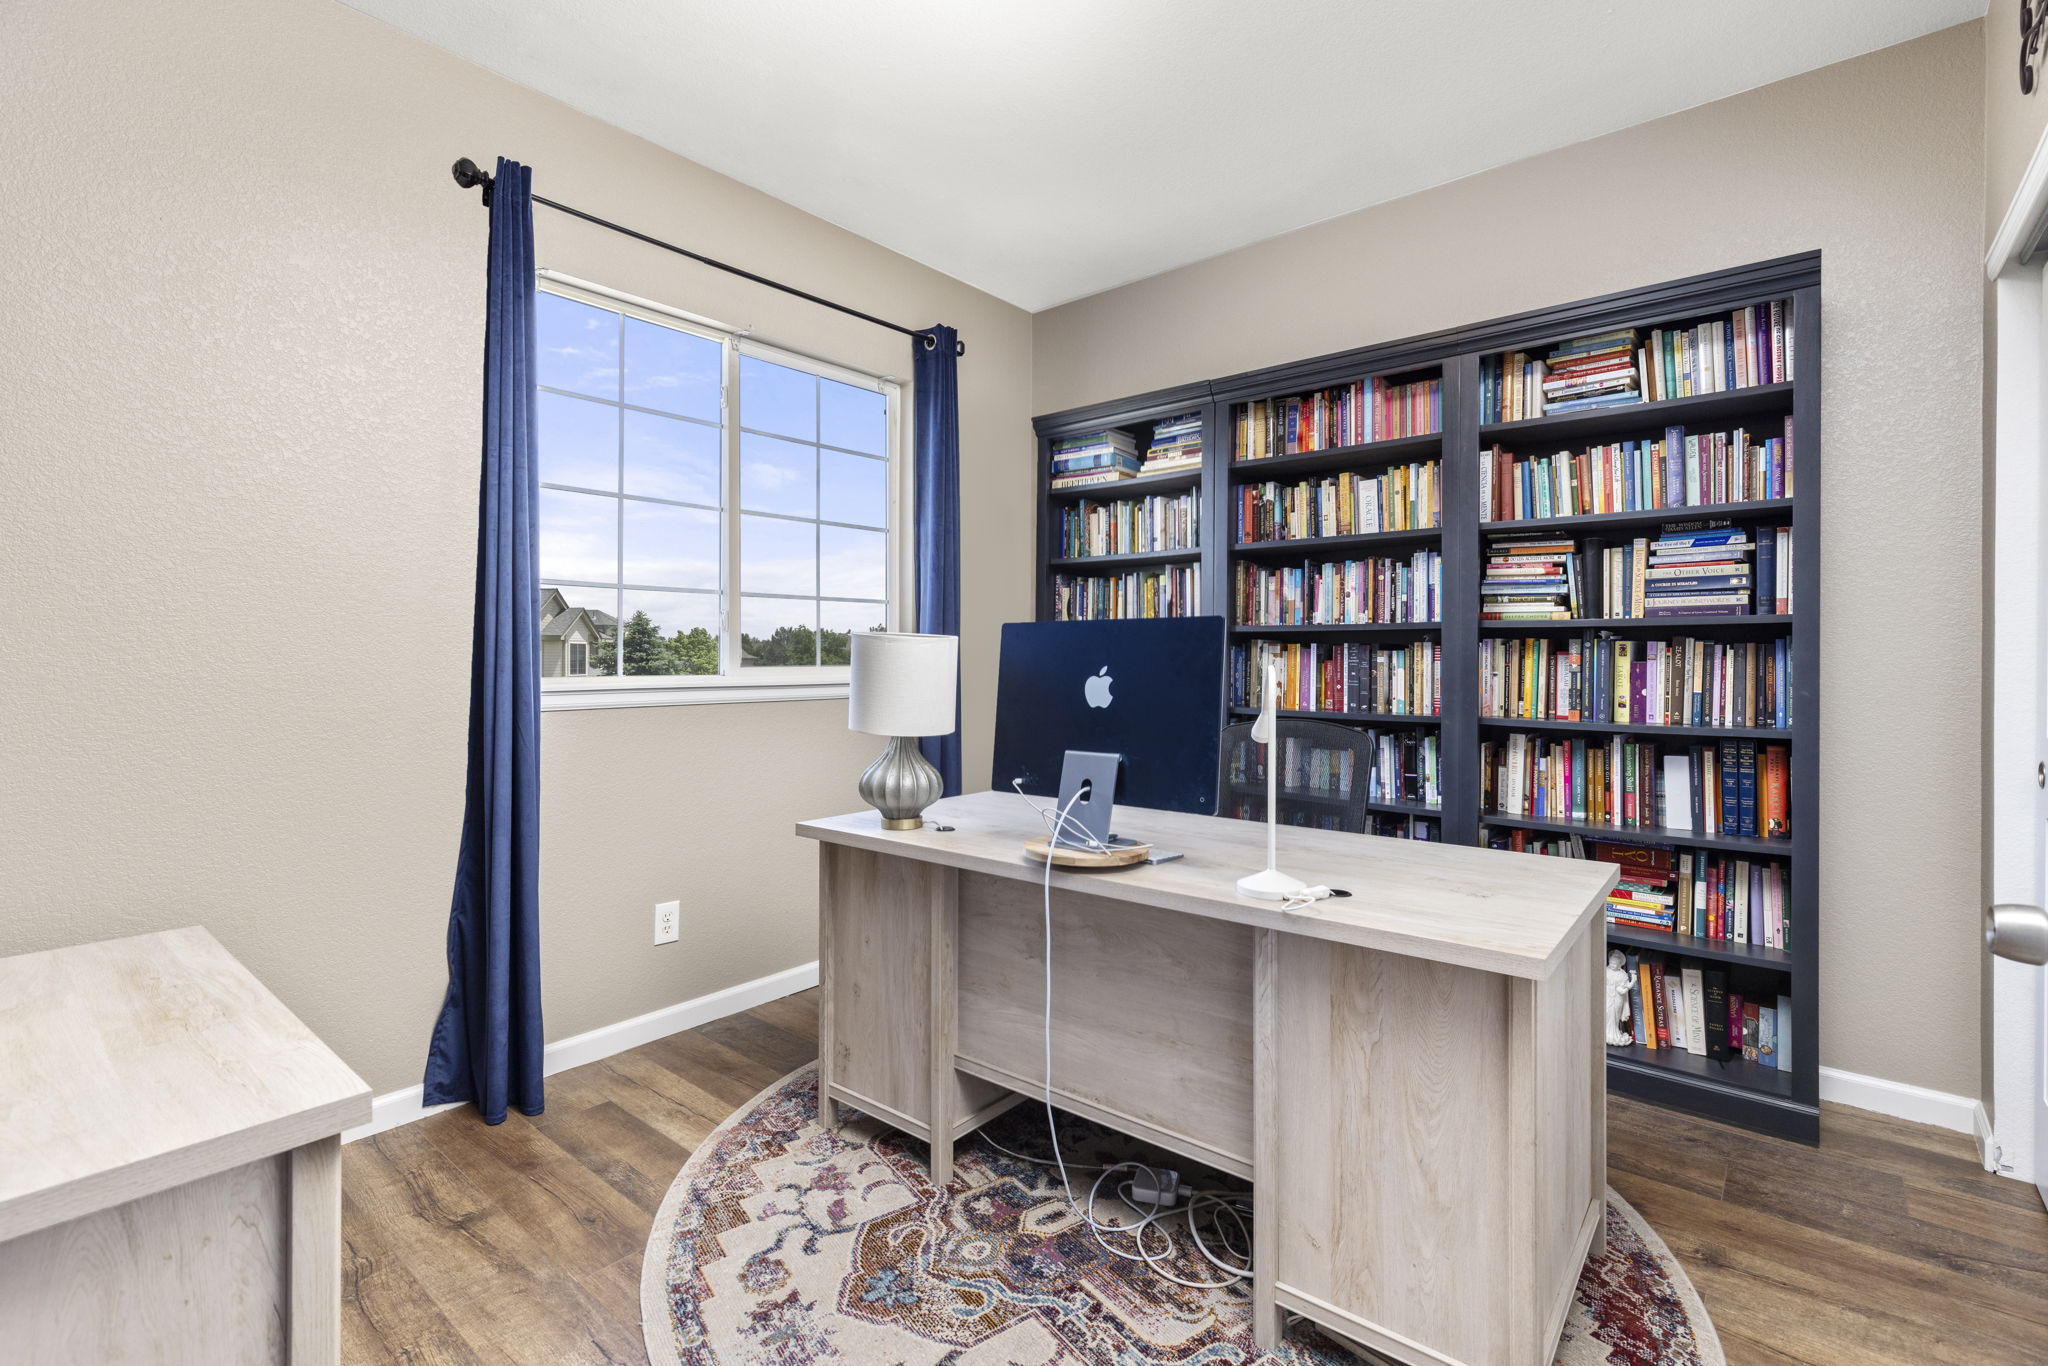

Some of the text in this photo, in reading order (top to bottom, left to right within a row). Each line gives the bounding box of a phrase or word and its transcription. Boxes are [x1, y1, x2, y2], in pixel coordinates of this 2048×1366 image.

[1061, 475, 1108, 488] BEETHOVEN
[1652, 599, 1678, 607] JOURNEY
[1626, 777, 1634, 791] Shakti
[1654, 975, 1665, 1027] RADIANCE SUTRAS
[1689, 988, 1701, 1015] SCIENCE
[1692, 1025, 1702, 1043] MIND
